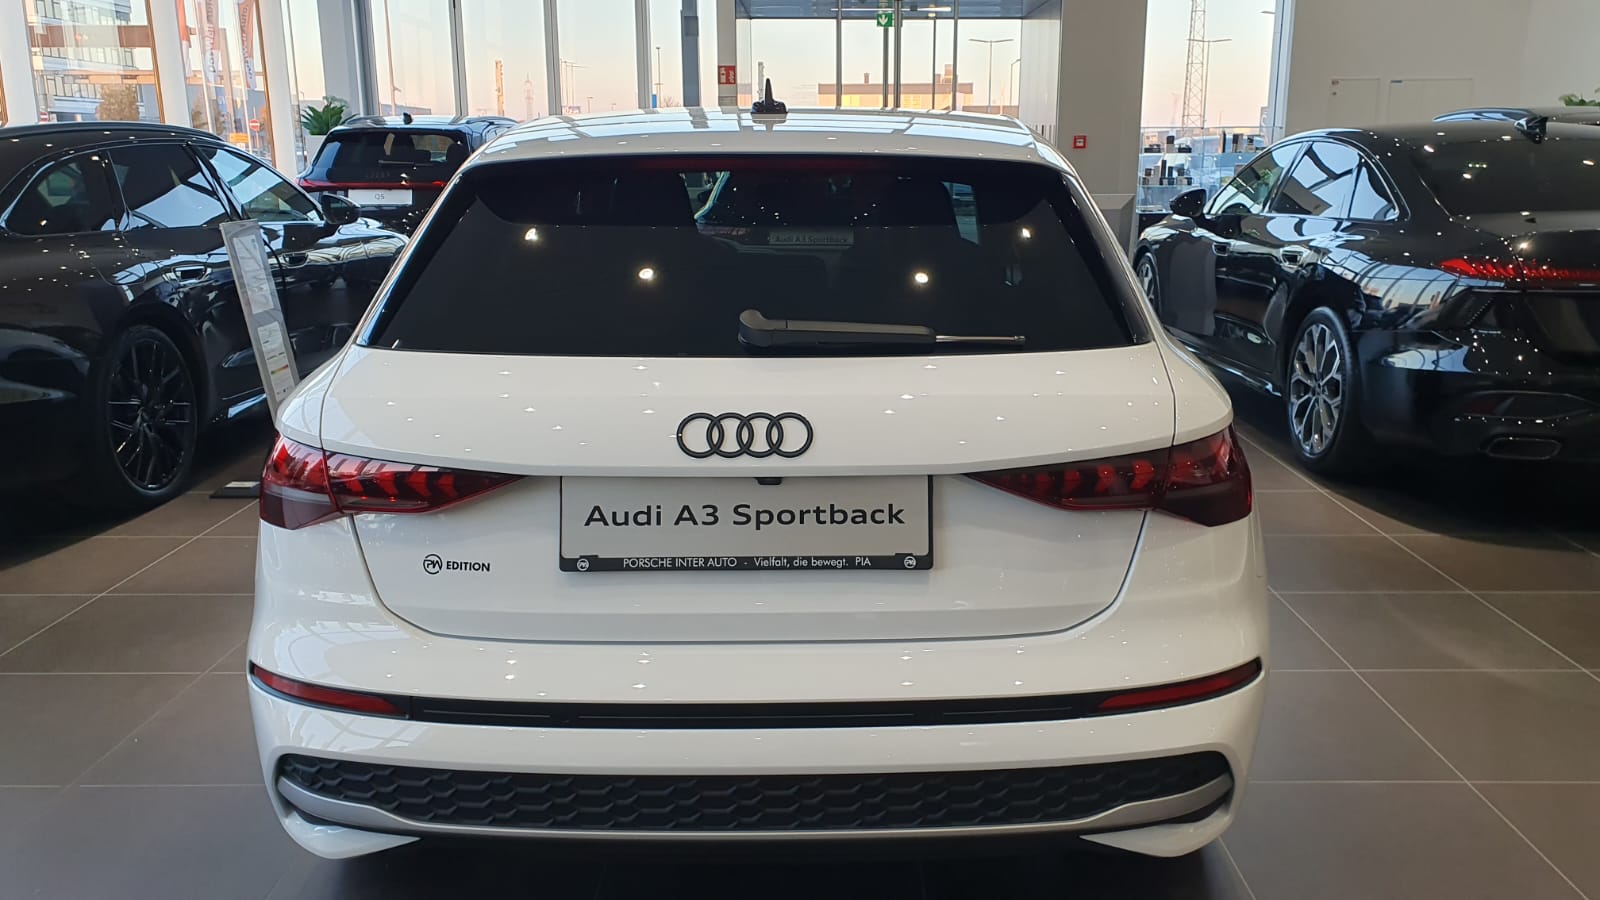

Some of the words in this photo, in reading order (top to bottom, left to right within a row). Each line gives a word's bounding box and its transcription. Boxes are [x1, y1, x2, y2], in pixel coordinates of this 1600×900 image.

[584, 505, 662, 527] Audi
[673, 504, 720, 526] A3
[732, 503, 905, 531] Sportback
[446, 560, 491, 572] EDITION
[623, 557, 673, 569] PORSCHE
[675, 557, 705, 568] INTER
[706, 557, 738, 567] AUTO
[753, 556, 790, 568] Vielfalt,
[793, 556, 808, 567] die
[811, 556, 849, 568] bewegt.
[855, 556, 871, 566] PIA
